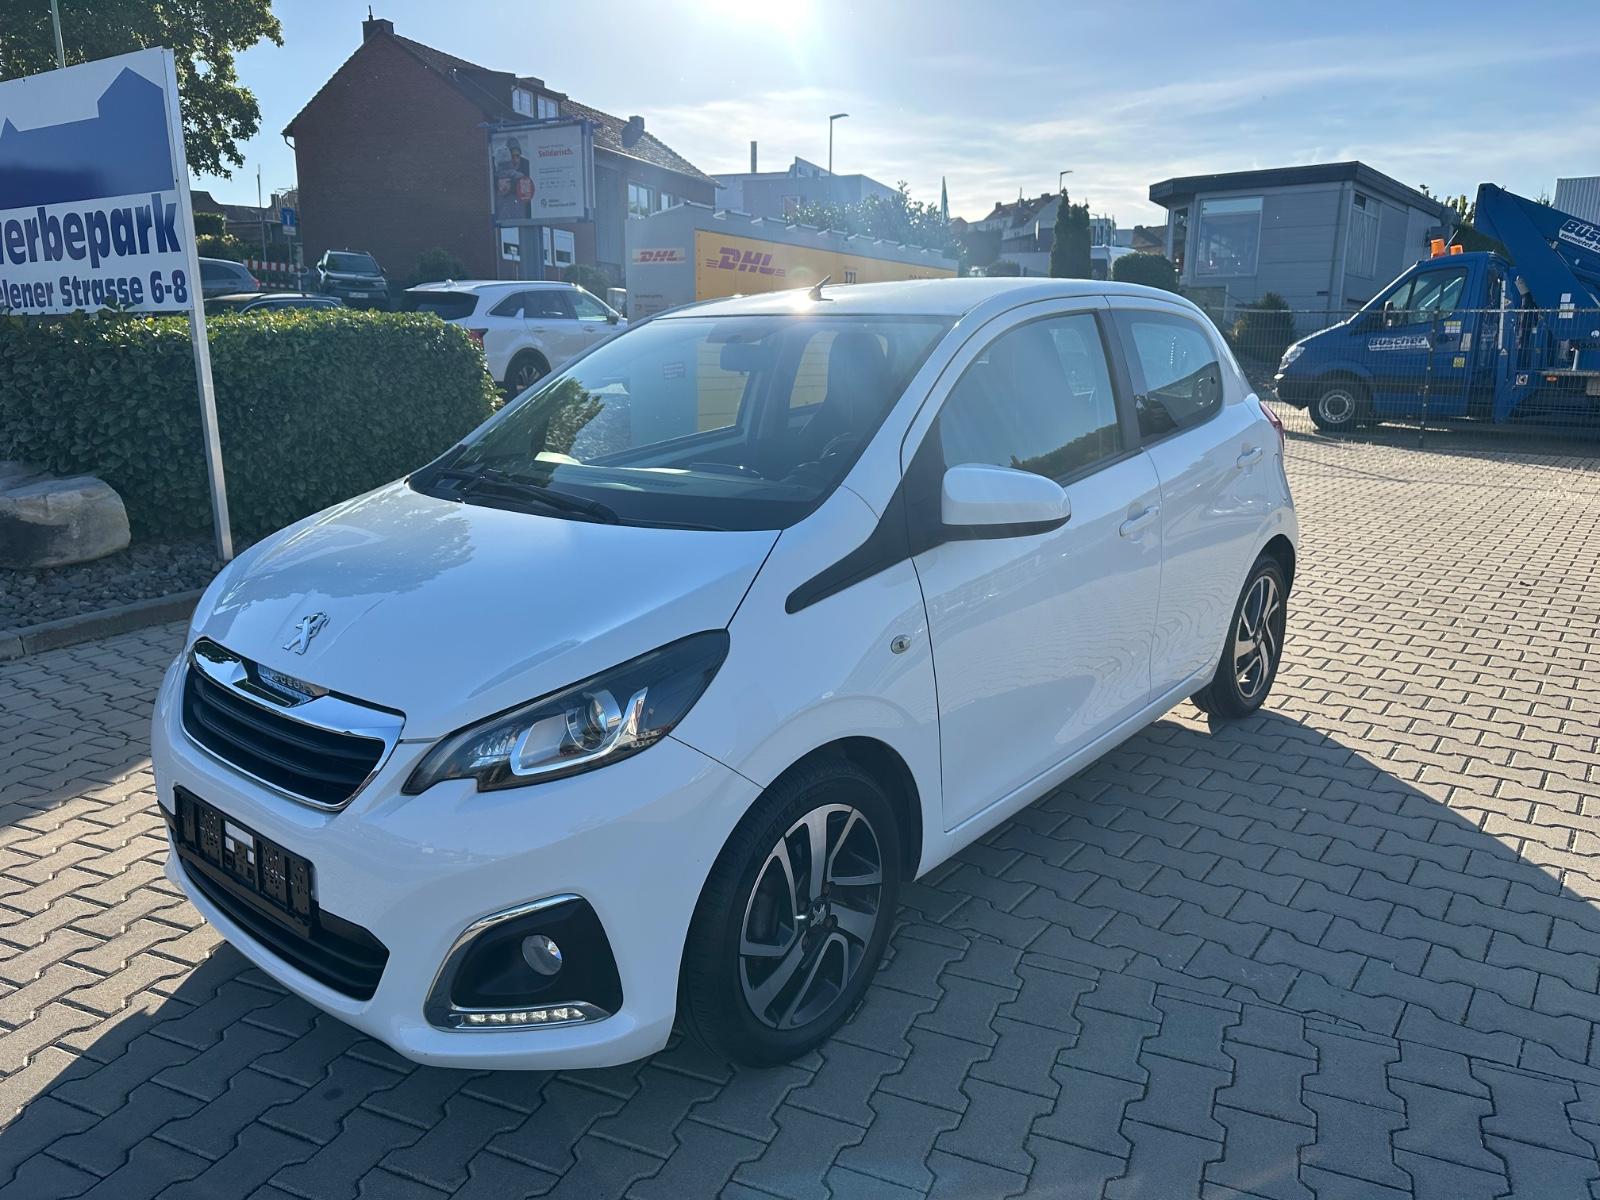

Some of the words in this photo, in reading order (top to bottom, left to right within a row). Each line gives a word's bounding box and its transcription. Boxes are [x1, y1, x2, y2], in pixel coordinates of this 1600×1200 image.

[639, 250, 678, 262] DHL
[719, 246, 776, 275] DHL
[59, 275, 144, 307] Strasse
[150, 269, 188, 304] 6-8
